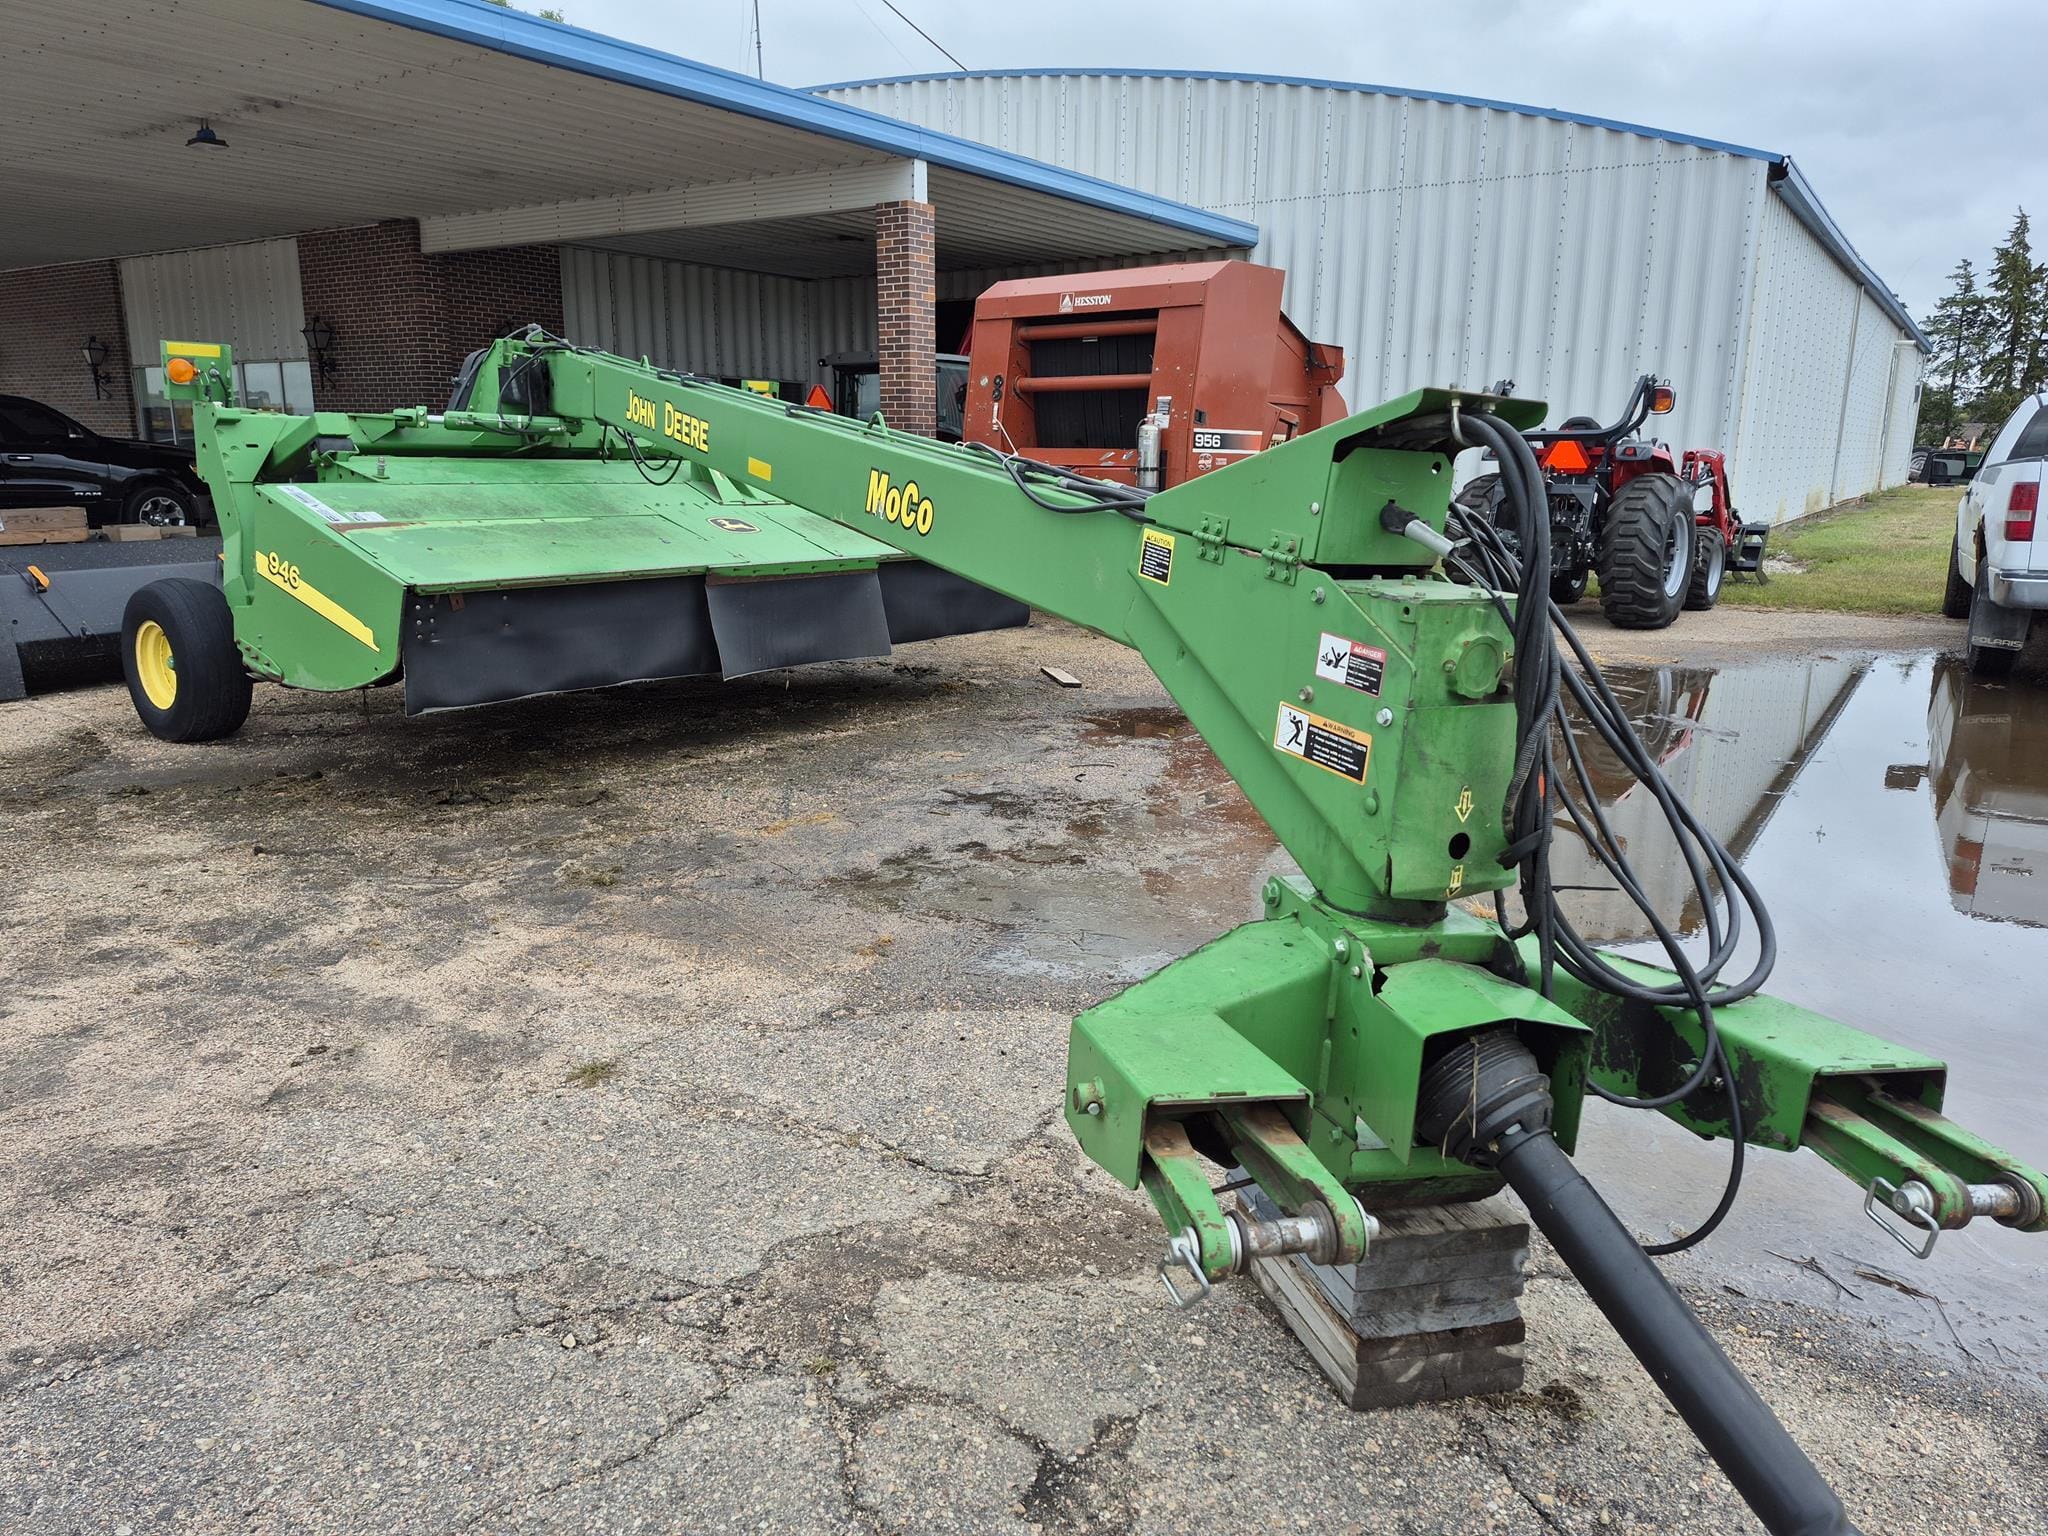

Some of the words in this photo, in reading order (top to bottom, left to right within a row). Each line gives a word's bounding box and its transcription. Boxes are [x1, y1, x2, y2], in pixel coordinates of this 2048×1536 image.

[1074, 294, 1112, 307] HESSTON
[625, 387, 656, 431] JOHN
[664, 400, 709, 454] DEERE
[1195, 433, 1221, 447] 956
[865, 467, 934, 537] MoCo
[267, 551, 300, 589] 946
[1971, 635, 2023, 648] POLARIS
[1327, 724, 1356, 738] WARNING
